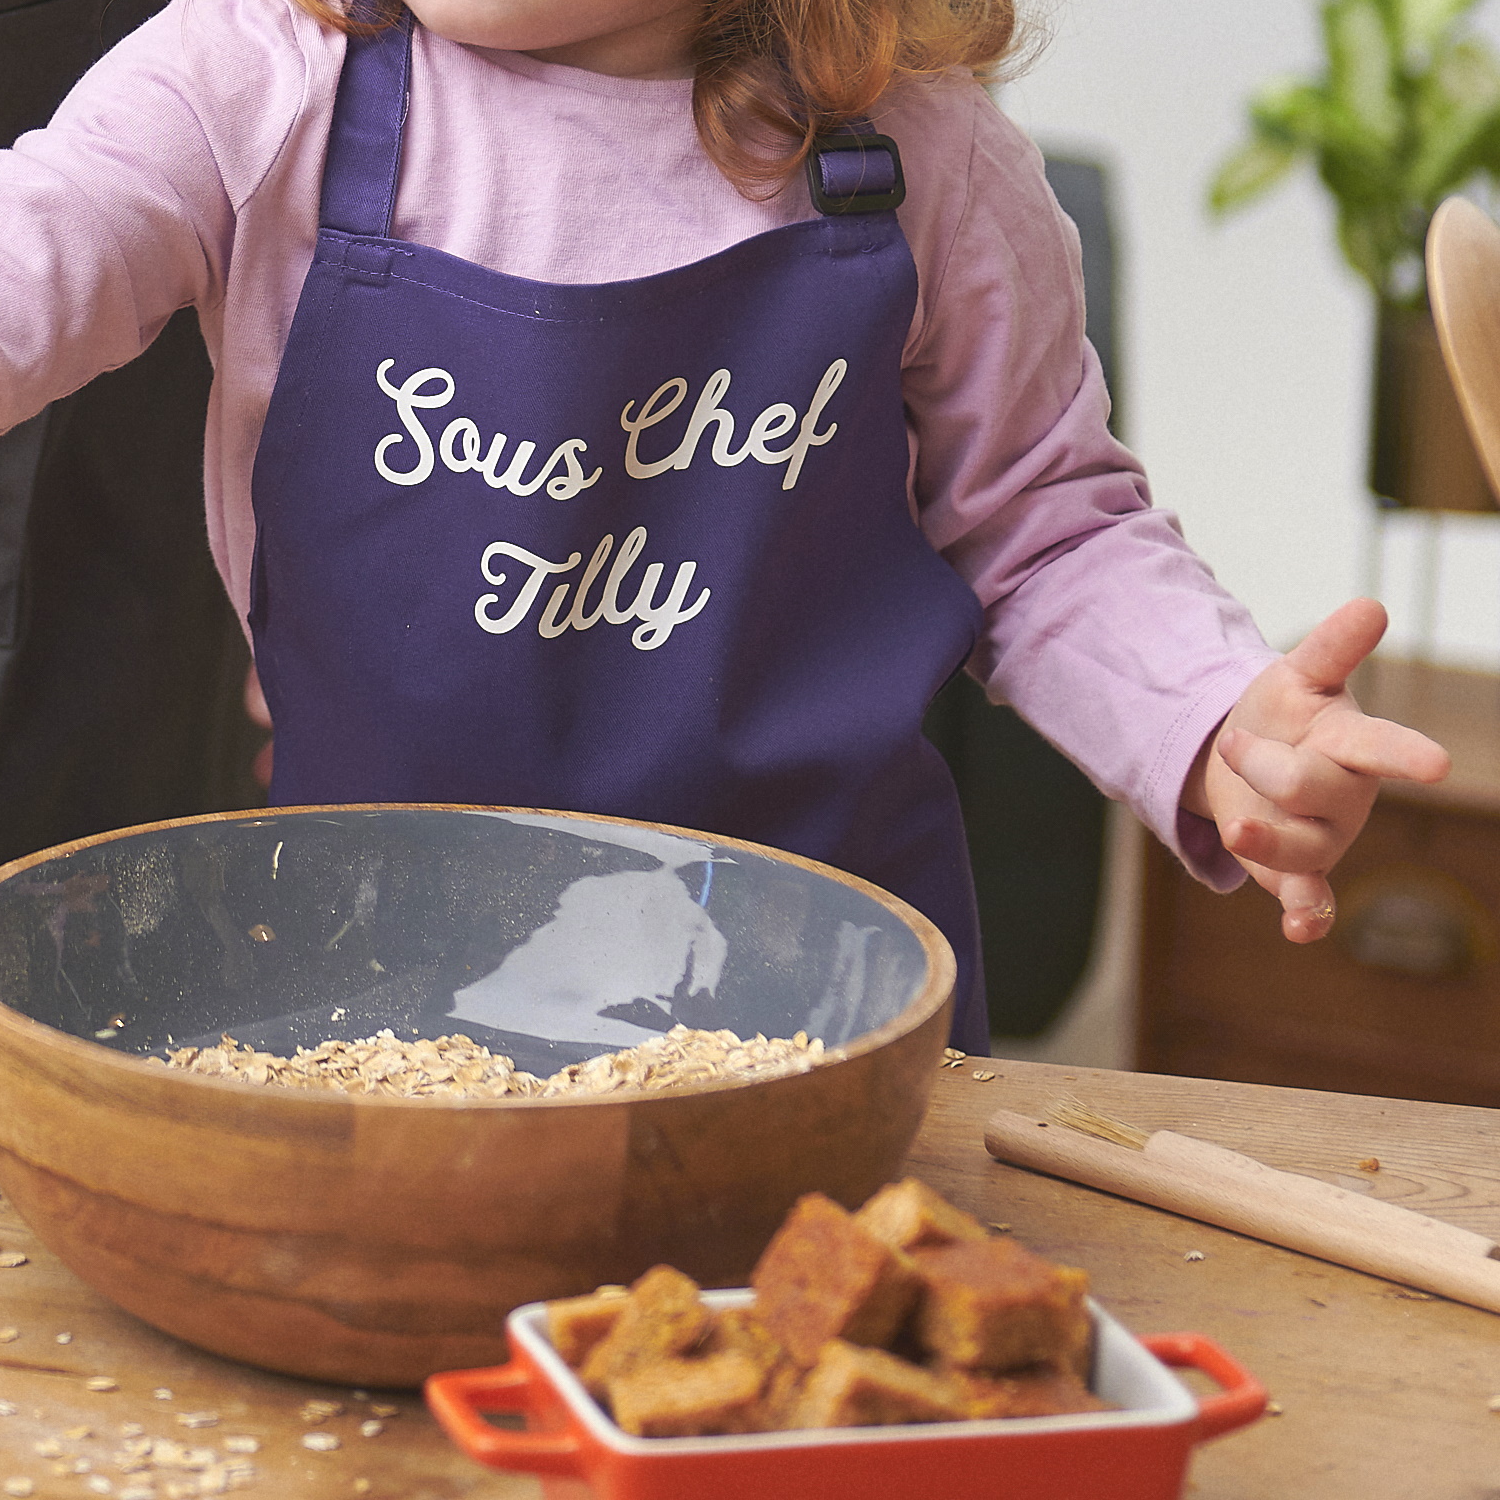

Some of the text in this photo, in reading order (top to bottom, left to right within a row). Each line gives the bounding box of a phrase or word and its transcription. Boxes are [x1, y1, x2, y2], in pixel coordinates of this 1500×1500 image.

[374, 357, 848, 501] Sous Chef
[474, 526, 712, 651] Tilly
